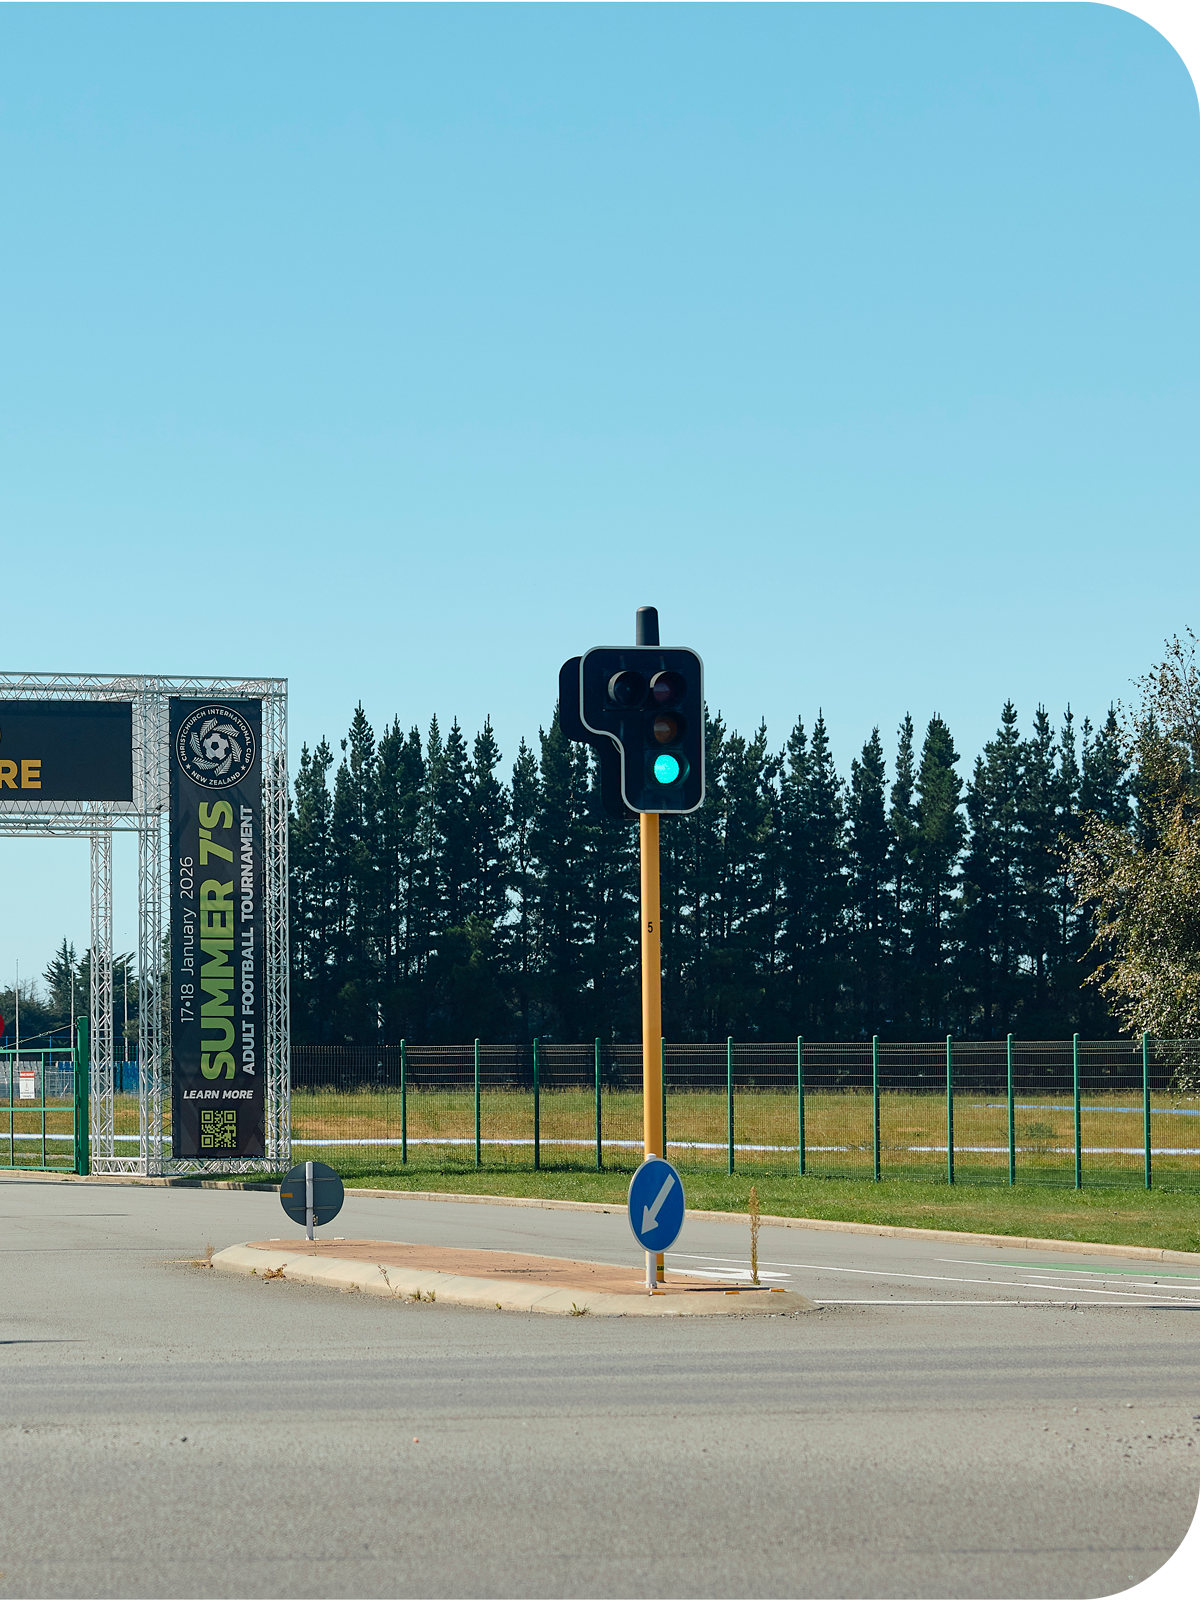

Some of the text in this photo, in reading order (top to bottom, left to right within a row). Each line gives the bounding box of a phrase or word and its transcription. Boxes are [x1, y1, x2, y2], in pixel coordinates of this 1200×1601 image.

[180, 710, 206, 761] CHRISTCHURCH
[207, 708, 251, 746] INTERNATIONAL
[191, 770, 241, 786] NEW ZEALAND
[179, 856, 194, 900] 2026
[180, 907, 197, 976] January
[240, 804, 256, 1076] ADULT FOOTBALL TOURNAMENT
[647, 921, 653, 933] 5
[199, 879, 236, 1080] SUMMER
[183, 1089, 254, 1100] LEARN MORE
